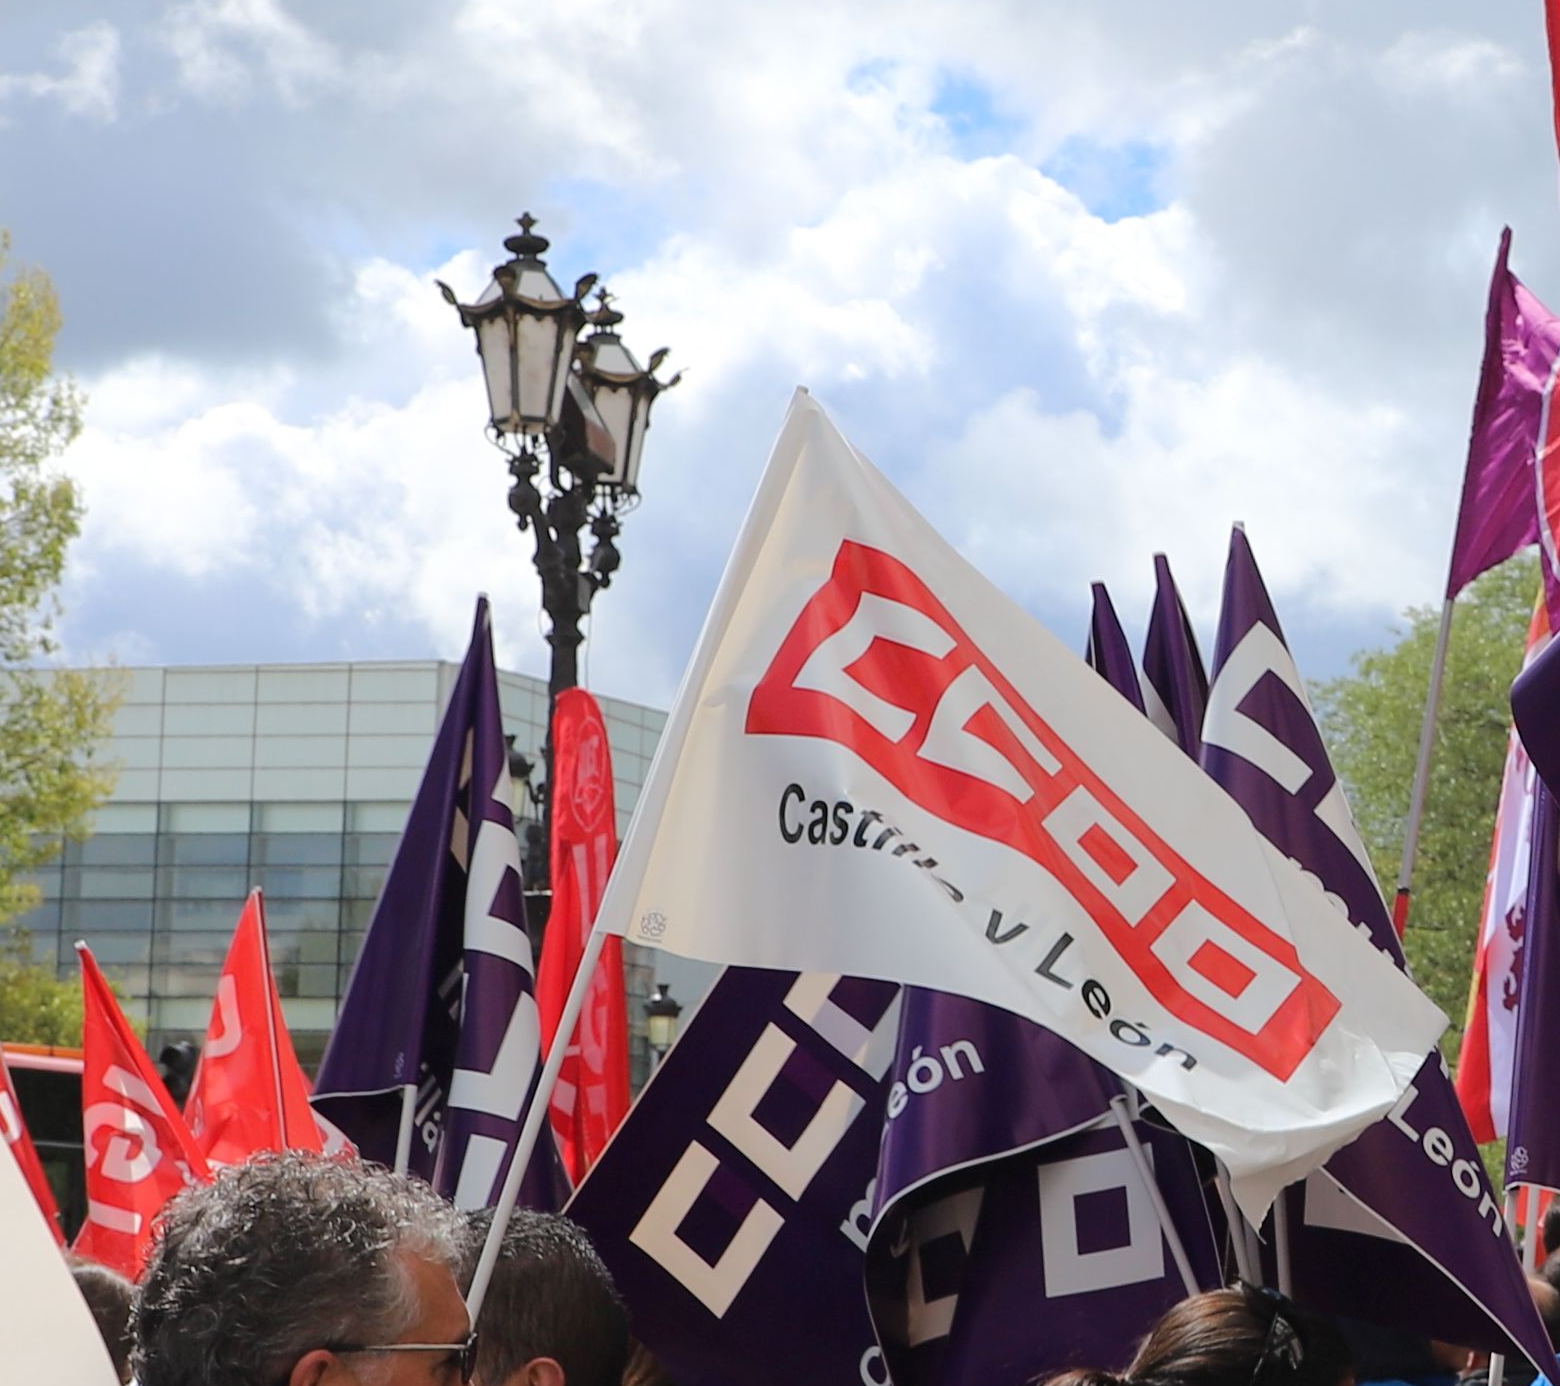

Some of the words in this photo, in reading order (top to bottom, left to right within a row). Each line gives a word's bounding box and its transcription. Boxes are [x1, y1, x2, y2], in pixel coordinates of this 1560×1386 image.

[794, 589, 1302, 1036] CCOO
[778, 782, 966, 904] Casti
[1034, 931, 1198, 1073] León
[886, 1036, 985, 1120] eón
[1387, 1083, 1504, 1238] León
